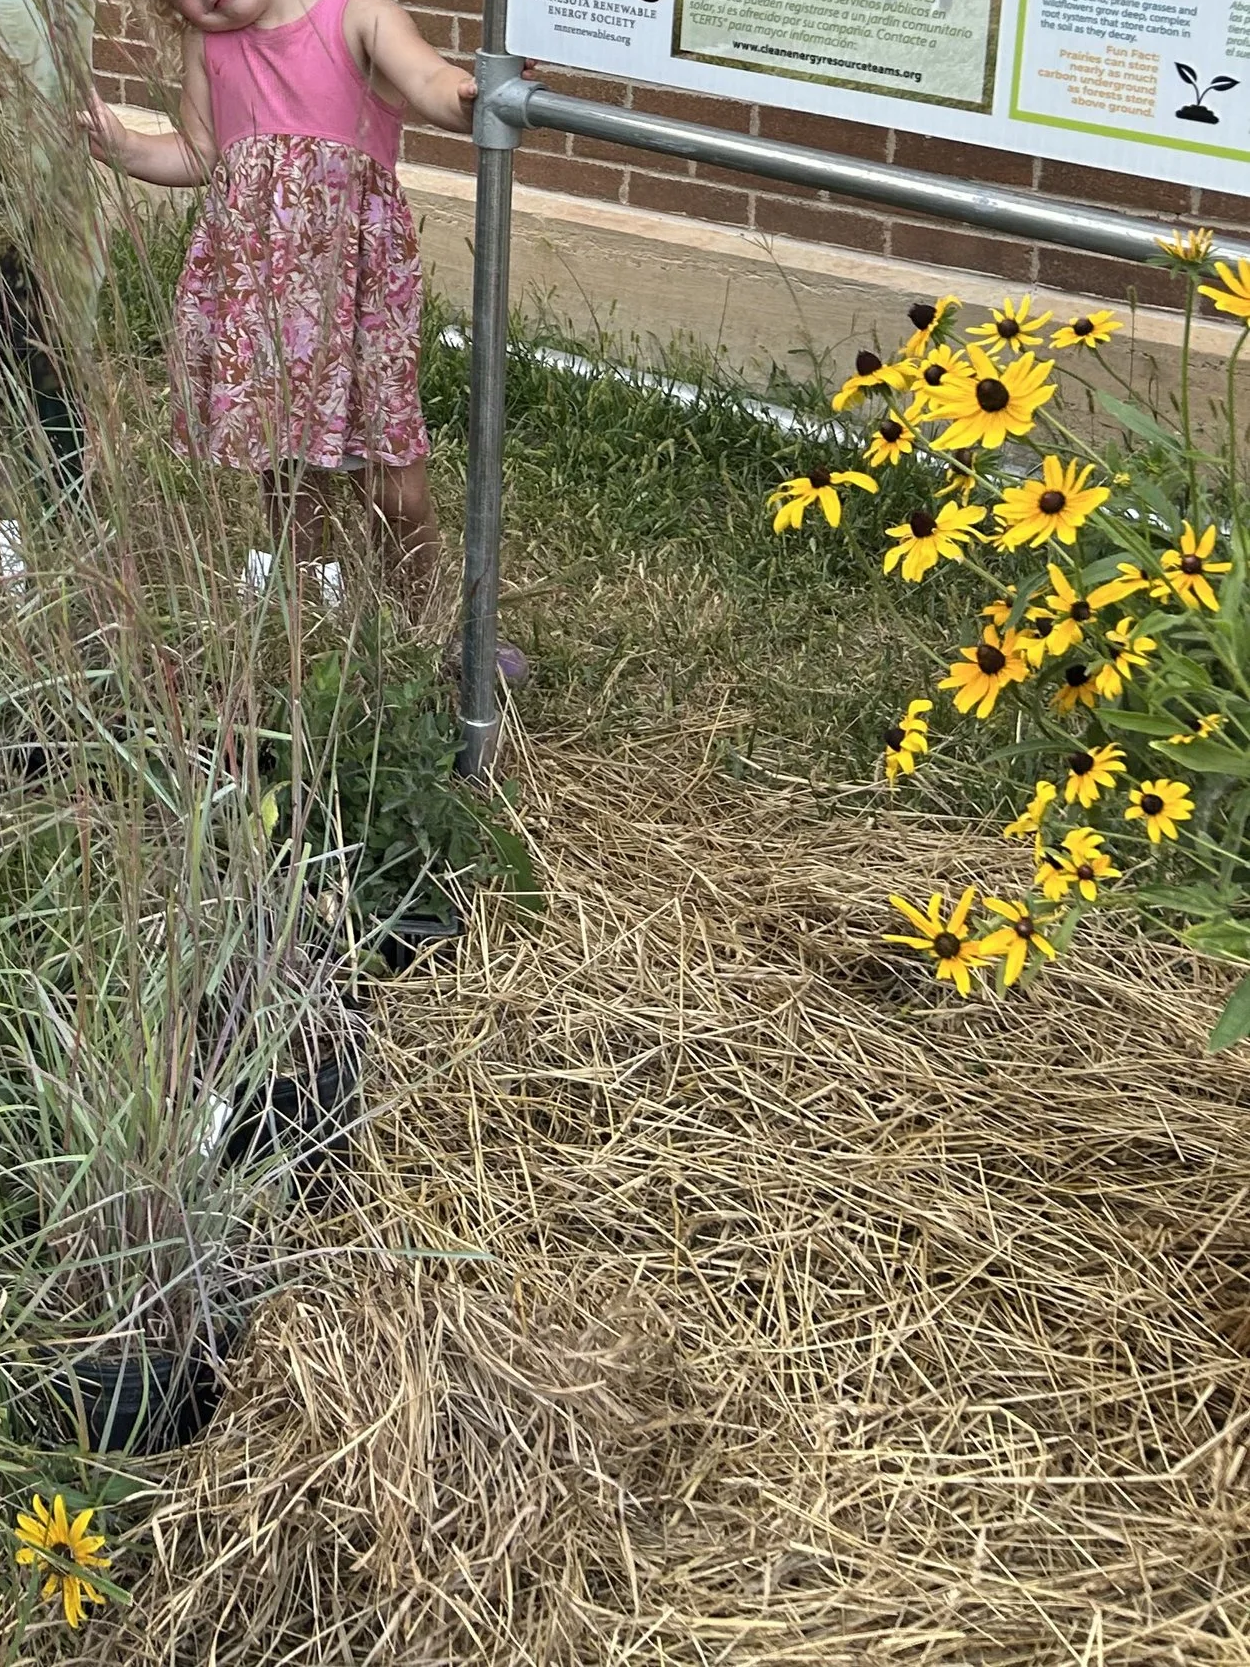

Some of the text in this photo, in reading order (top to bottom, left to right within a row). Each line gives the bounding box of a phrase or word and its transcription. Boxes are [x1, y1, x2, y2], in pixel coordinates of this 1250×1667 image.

[548, 5, 636, 29] ENERGY SOCIETY
[593, 0, 657, 19] RENEWABLE
